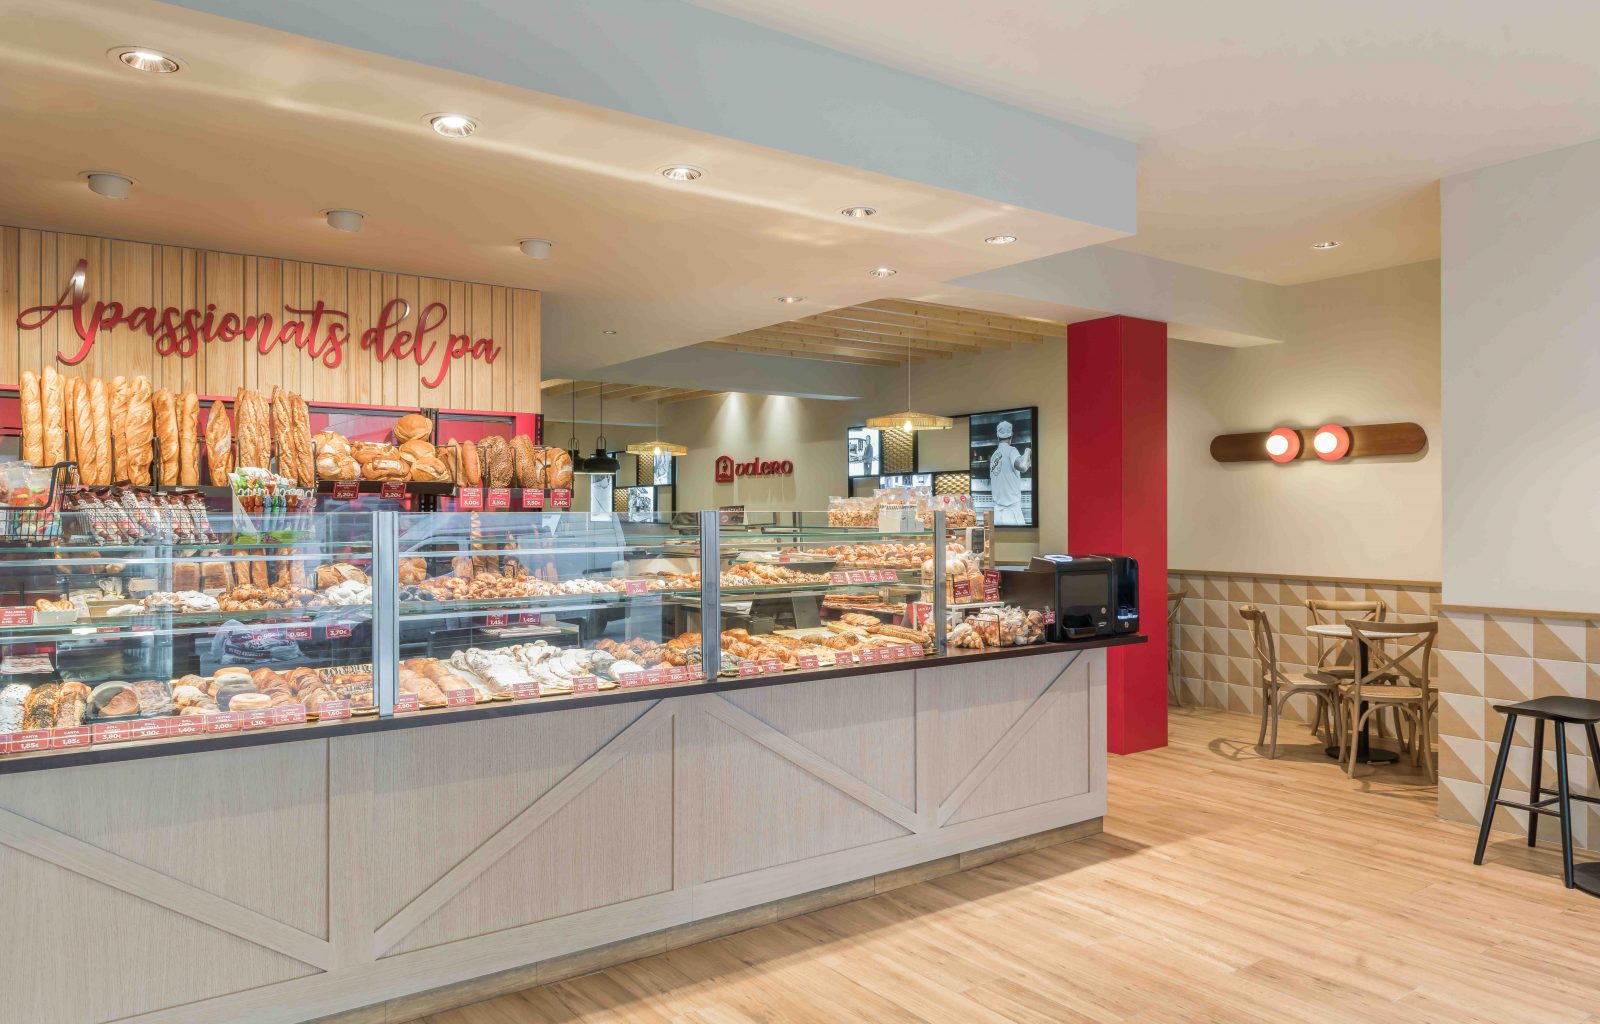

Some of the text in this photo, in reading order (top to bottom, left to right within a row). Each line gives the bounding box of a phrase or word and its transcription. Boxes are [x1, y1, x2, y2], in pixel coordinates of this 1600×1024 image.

[17, 258, 502, 389] Apassionats del pa
